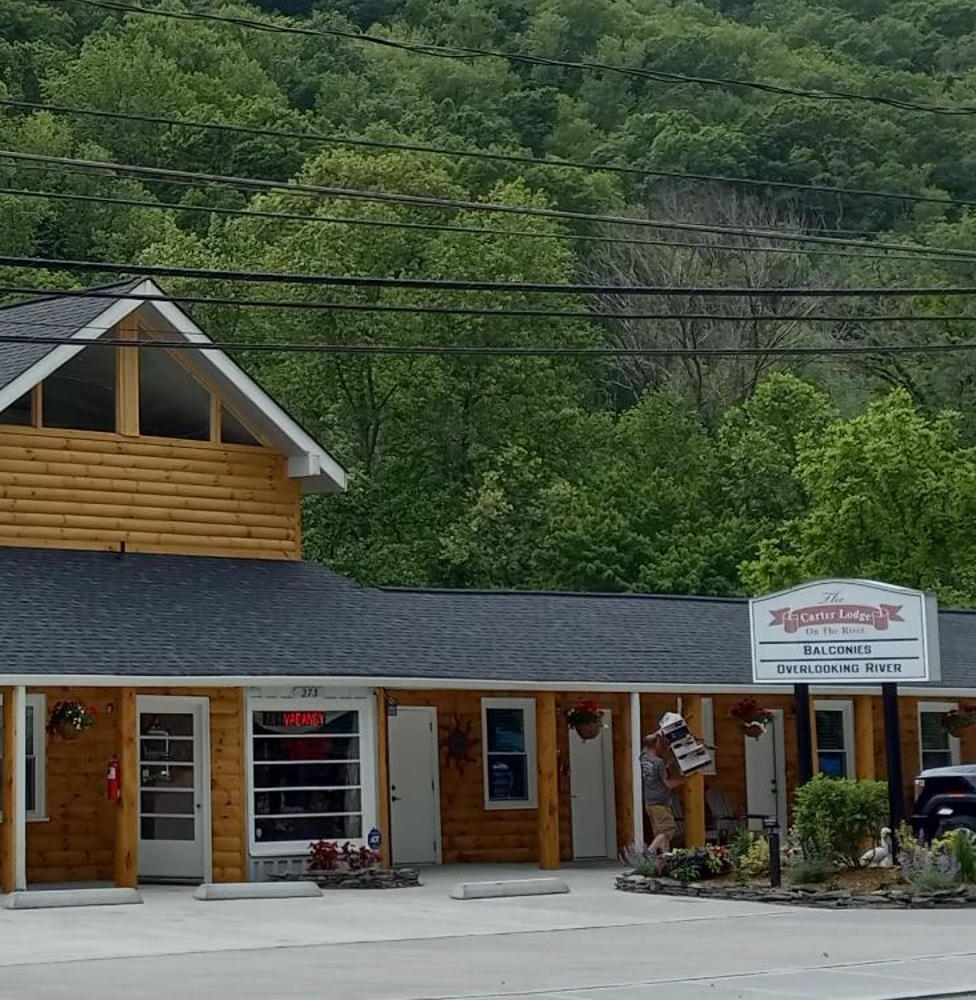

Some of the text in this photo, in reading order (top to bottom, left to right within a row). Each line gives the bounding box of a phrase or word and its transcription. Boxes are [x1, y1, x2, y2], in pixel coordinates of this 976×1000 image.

[821, 591, 844, 603] The
[800, 608, 872, 622] Carter Lodge
[805, 627, 819, 636] On
[823, 626, 838, 635] The
[804, 645, 872, 655] BALCONIES
[777, 662, 902, 674] OVERLOOKING RIVER
[301, 688, 318, 698] 273
[283, 711, 325, 727] VACANCY
